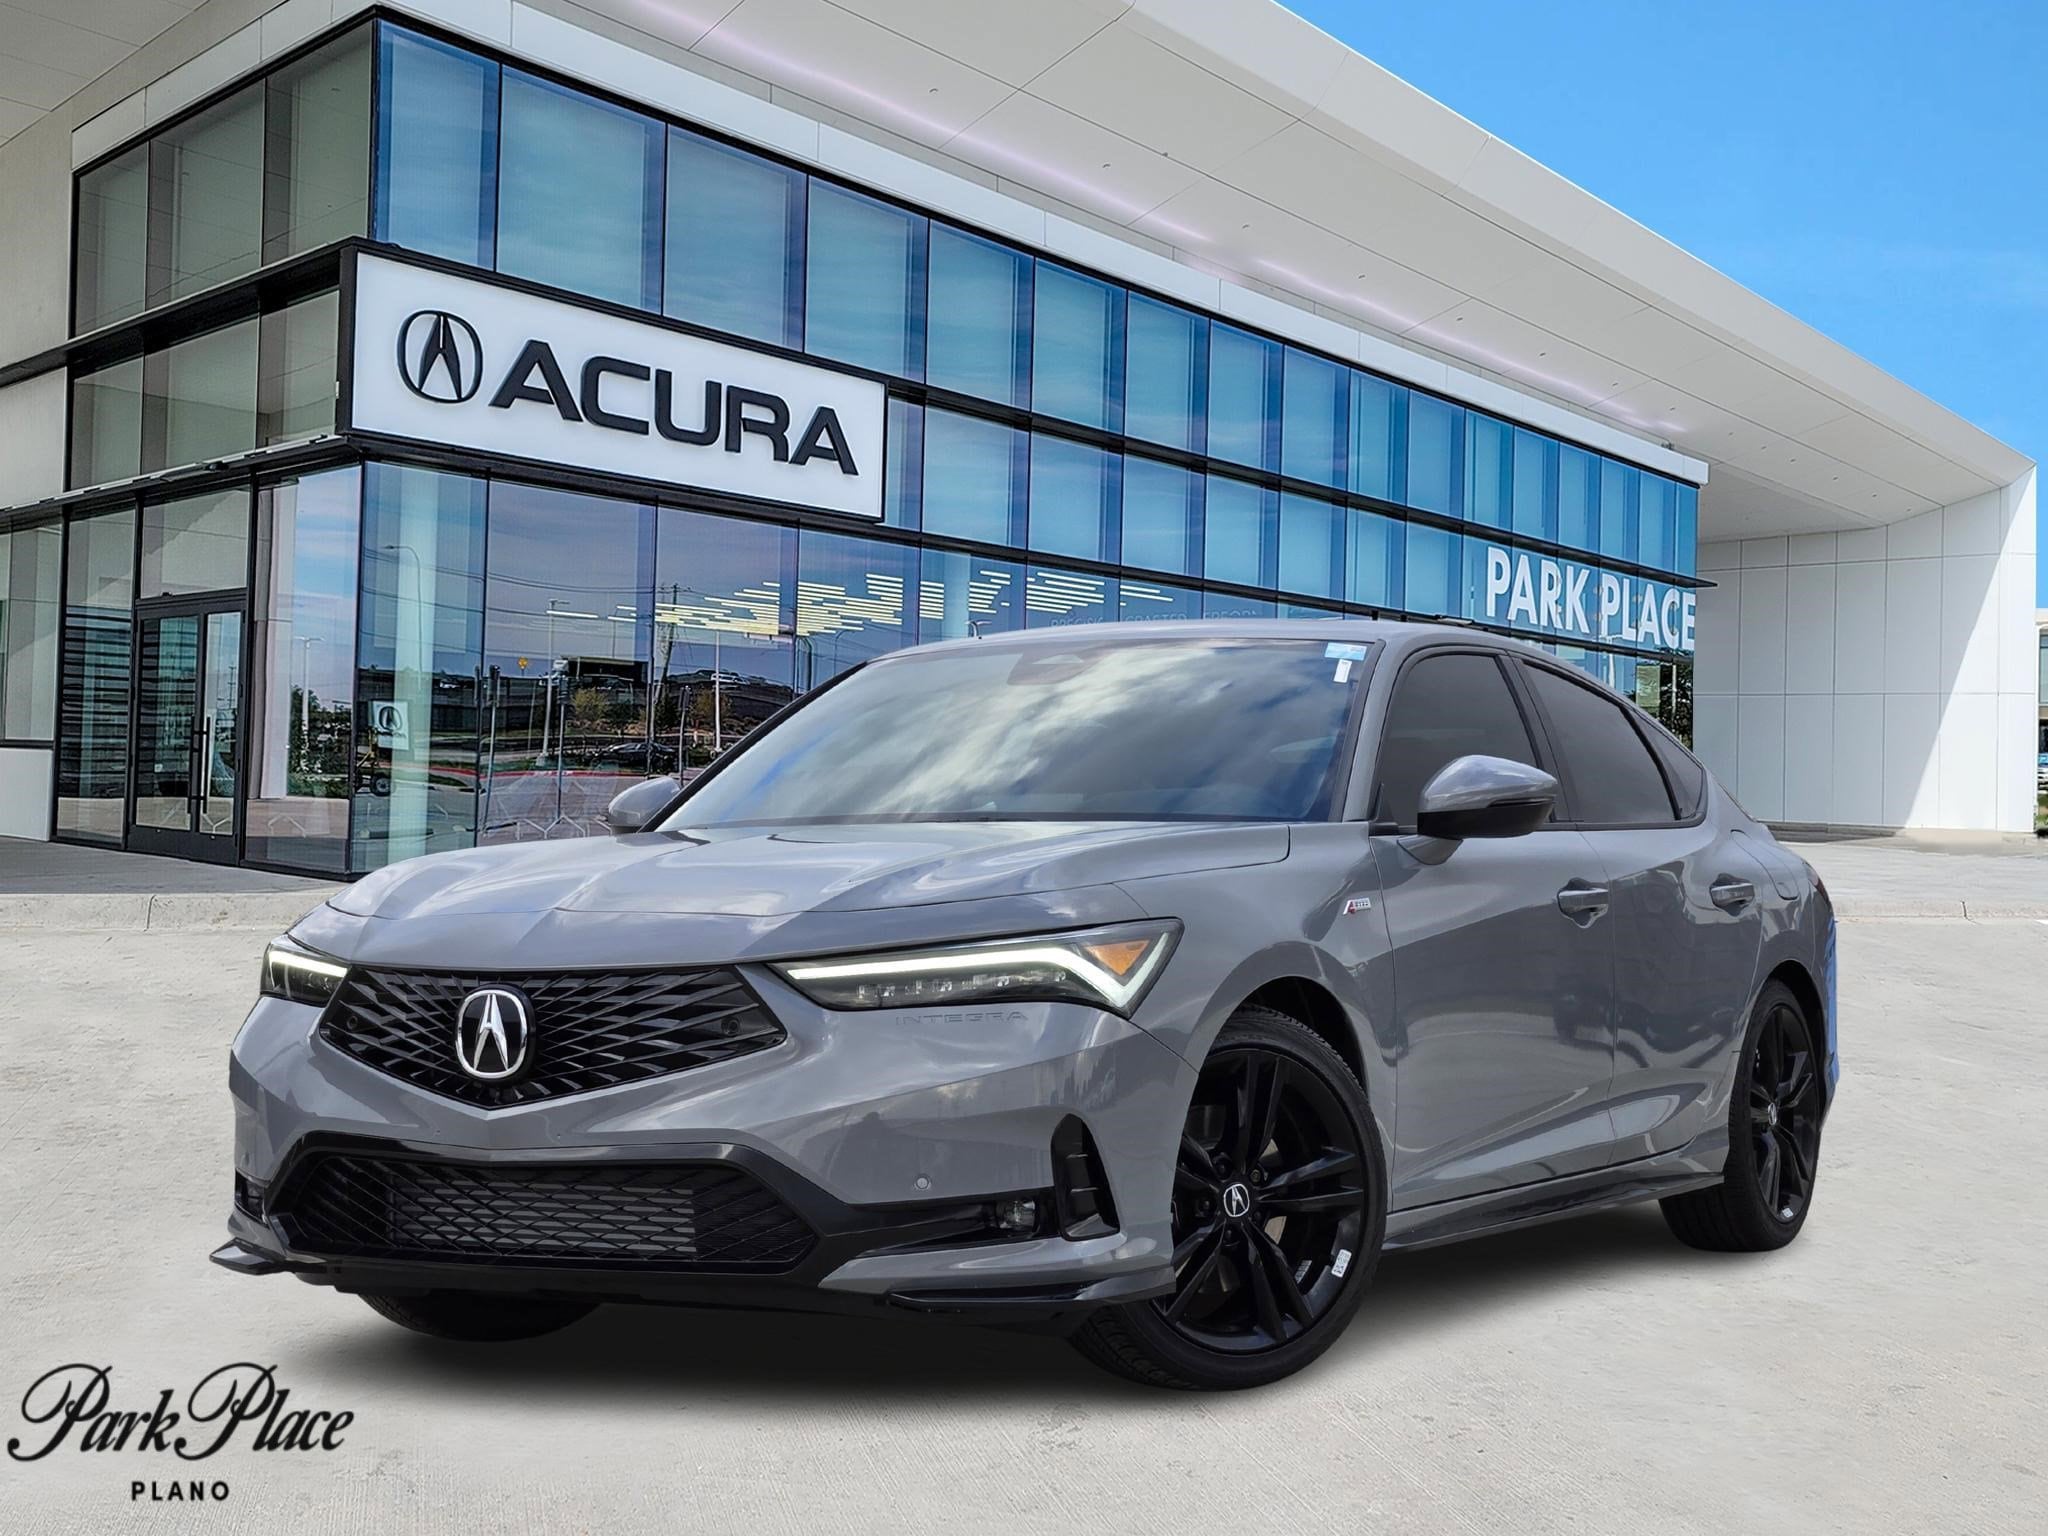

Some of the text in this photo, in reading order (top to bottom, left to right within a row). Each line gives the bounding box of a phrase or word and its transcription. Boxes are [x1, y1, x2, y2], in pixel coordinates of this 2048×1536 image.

[488, 339, 859, 476] ACURA
[1486, 546, 1697, 650] PARK PLACE
[895, 1011, 1028, 1026] INTEGRA
